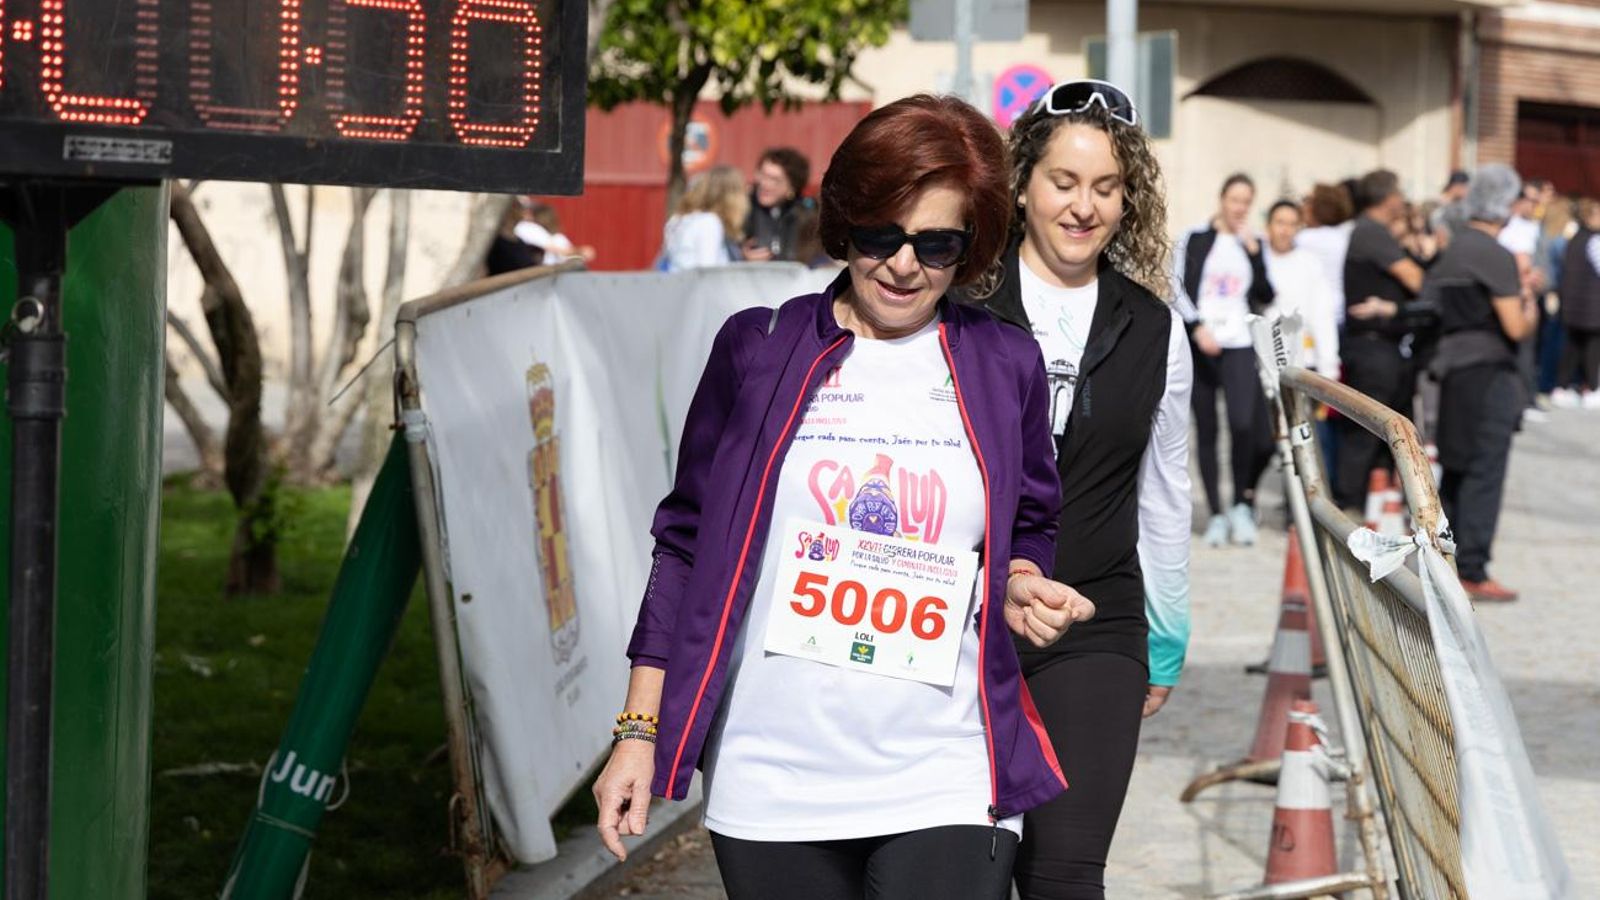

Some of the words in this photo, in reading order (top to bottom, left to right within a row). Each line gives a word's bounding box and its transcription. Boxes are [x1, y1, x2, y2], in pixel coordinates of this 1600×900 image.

[1271, 317, 1289, 372] tamie
[821, 392, 864, 403] POPULAR
[817, 432, 836, 441] cada
[917, 550, 956, 566] POPULAR
[790, 571, 949, 641] 5006
[855, 632, 874, 643] LOLI
